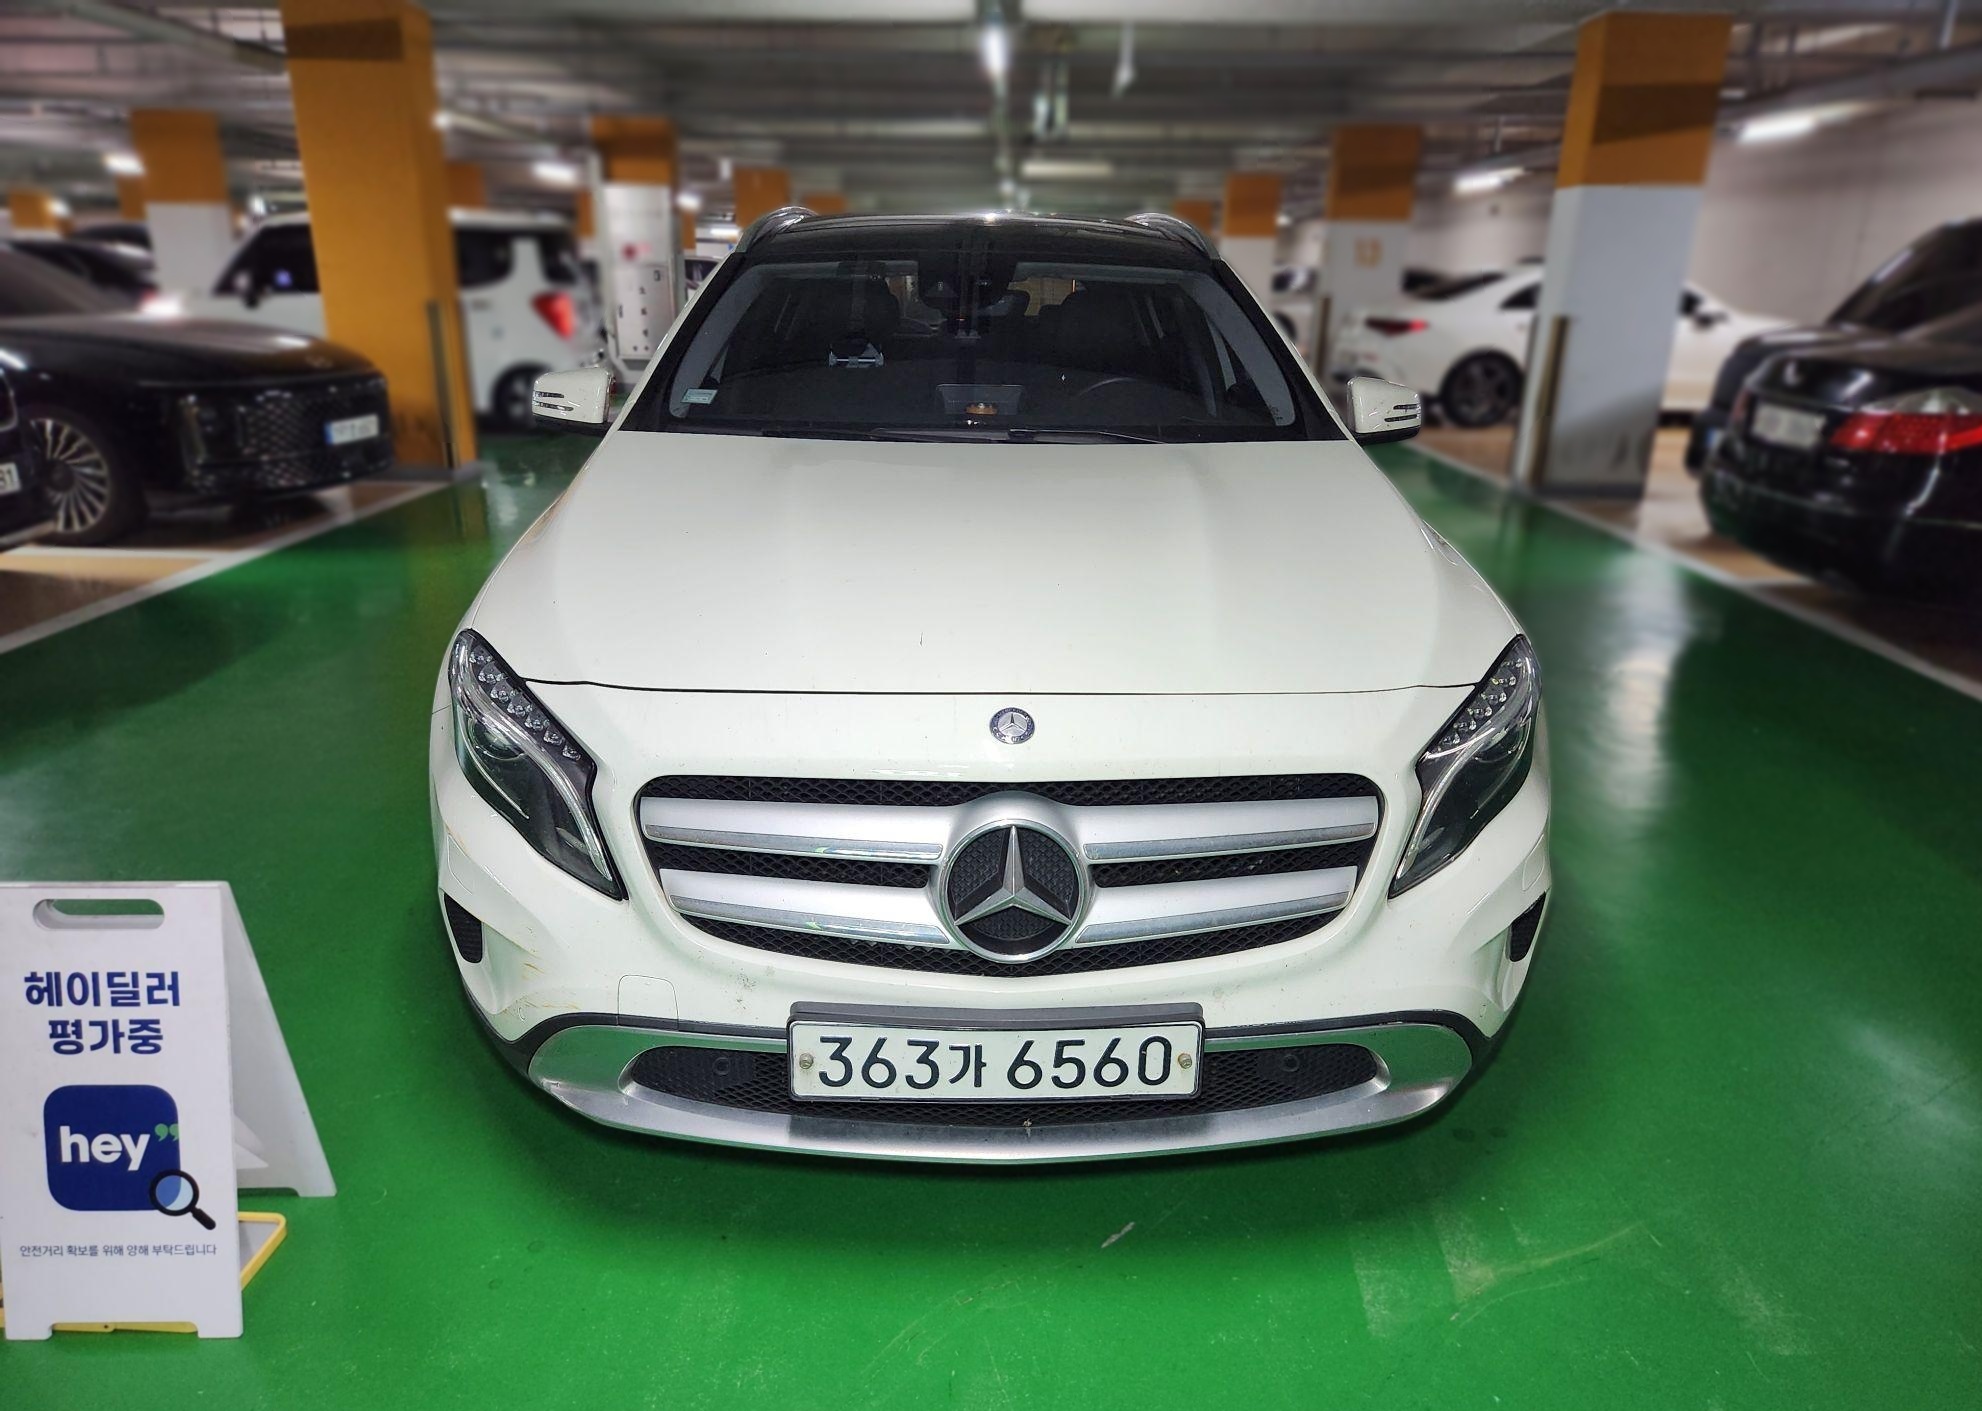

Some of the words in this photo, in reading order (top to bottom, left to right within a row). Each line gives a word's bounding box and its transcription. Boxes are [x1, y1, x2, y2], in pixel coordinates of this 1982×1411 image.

[24, 971, 180, 1007] 헤이딜러
[48, 1018, 163, 1055] 평가중
[818, 1035, 987, 1090] 363가
[1006, 1035, 1173, 1090] 6560
[19, 1245, 64, 1257] 안전거리
[66, 1244, 99, 1257] 확보를
[102, 1244, 124, 1256] 위해
[126, 1244, 149, 1256] 양해
[152, 1244, 217, 1256] 부탁드립니다
